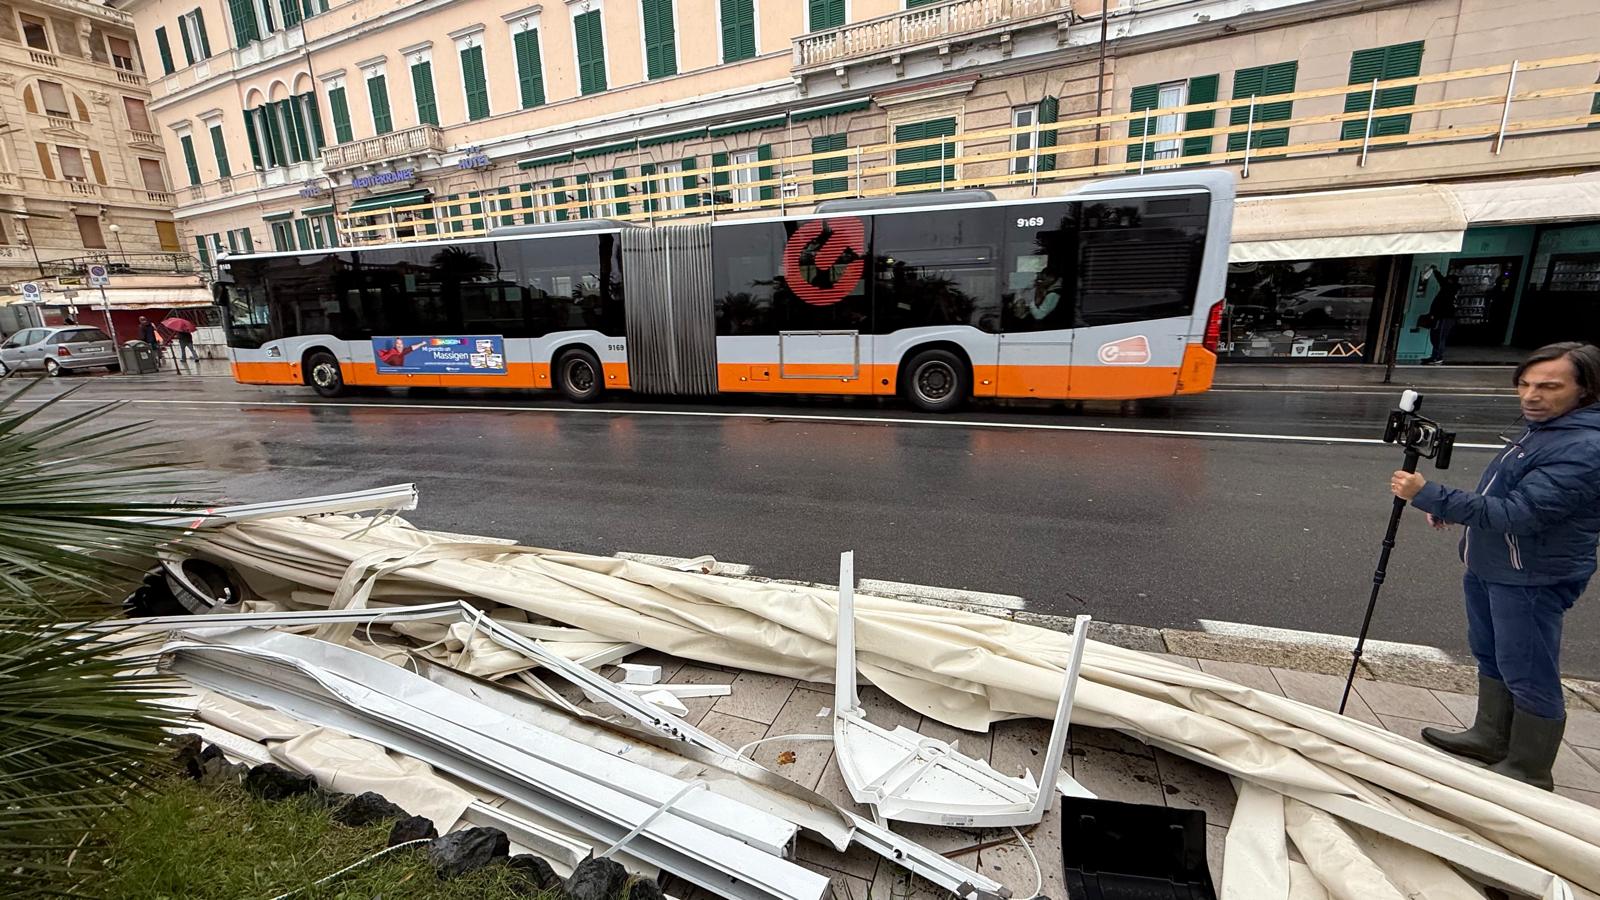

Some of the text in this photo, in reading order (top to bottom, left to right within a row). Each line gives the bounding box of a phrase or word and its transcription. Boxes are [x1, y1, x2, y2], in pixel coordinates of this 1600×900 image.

[458, 155, 491, 170] HOTEL
[352, 168, 415, 190] MEDITERRANEE
[1017, 216, 1044, 228] 9169
[433, 351, 469, 362] Massigen
